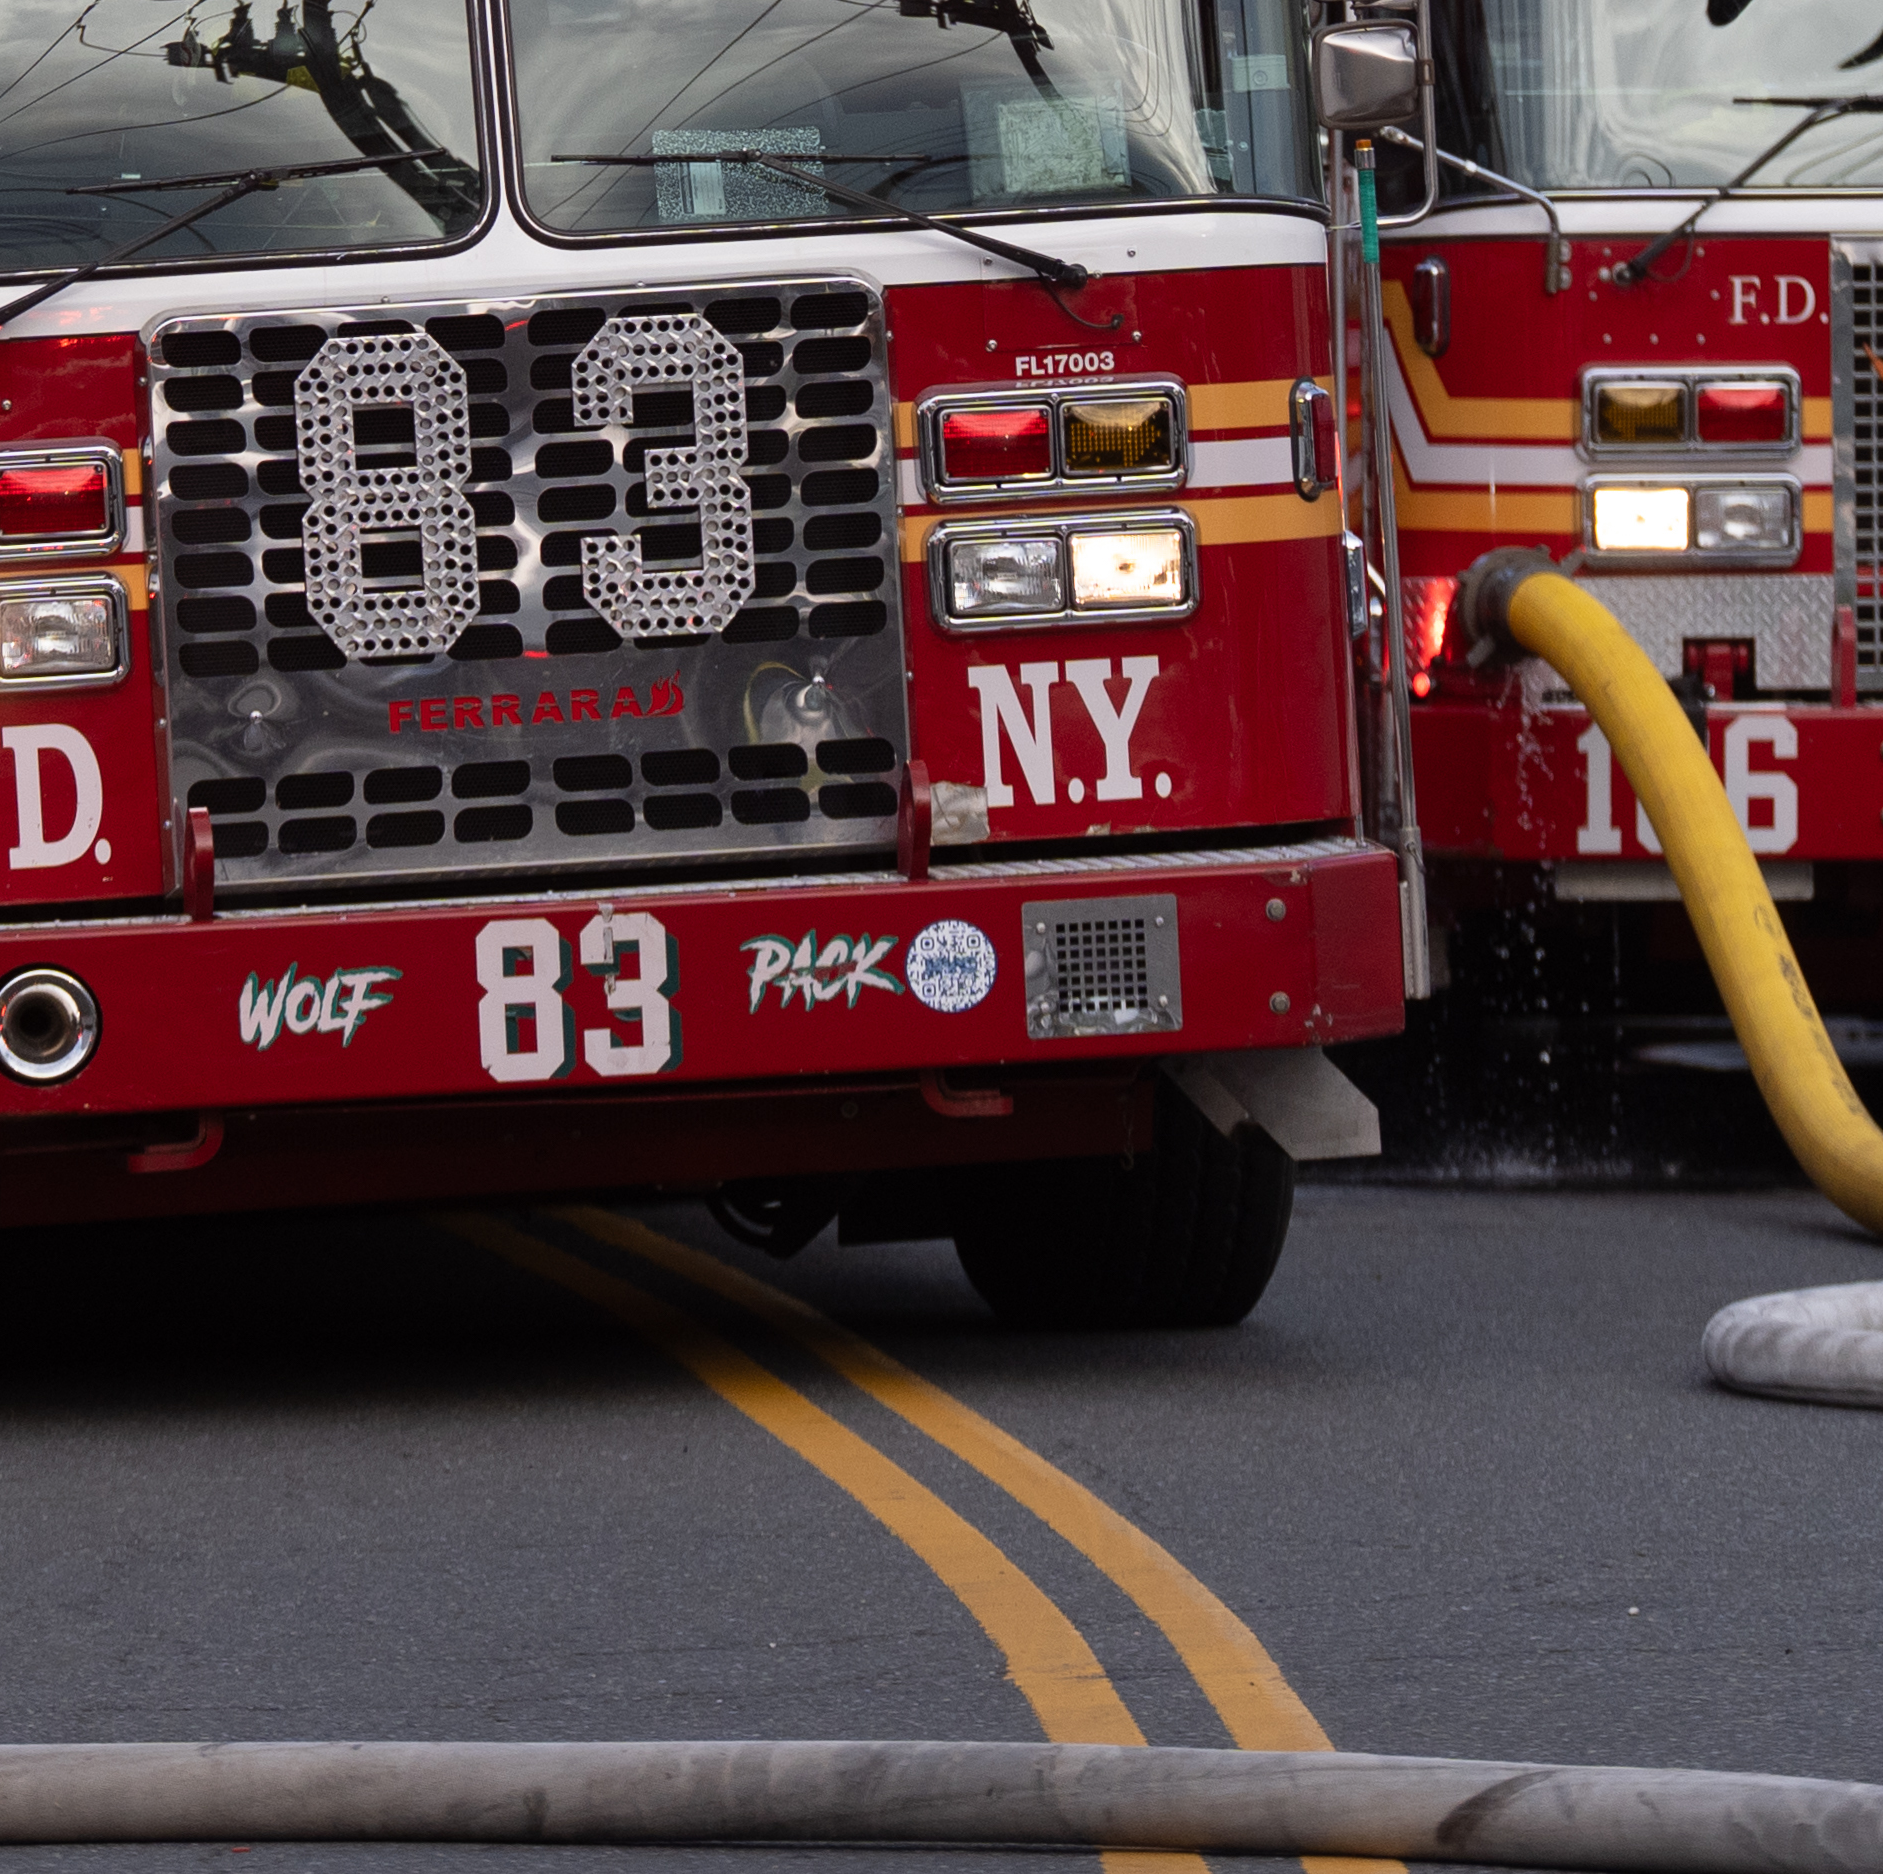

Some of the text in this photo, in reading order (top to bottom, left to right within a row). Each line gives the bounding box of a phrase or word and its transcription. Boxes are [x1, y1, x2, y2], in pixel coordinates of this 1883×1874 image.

[1015, 351, 1116, 377] FL17003
[1728, 275, 1830, 325] F.D.
[293, 313, 757, 660] 83
[388, 686, 644, 734] FERRARA
[967, 654, 1173, 809] N.Y.
[1577, 713, 1799, 855] 16
[238, 911, 906, 1083] WOLF 83 PACK
